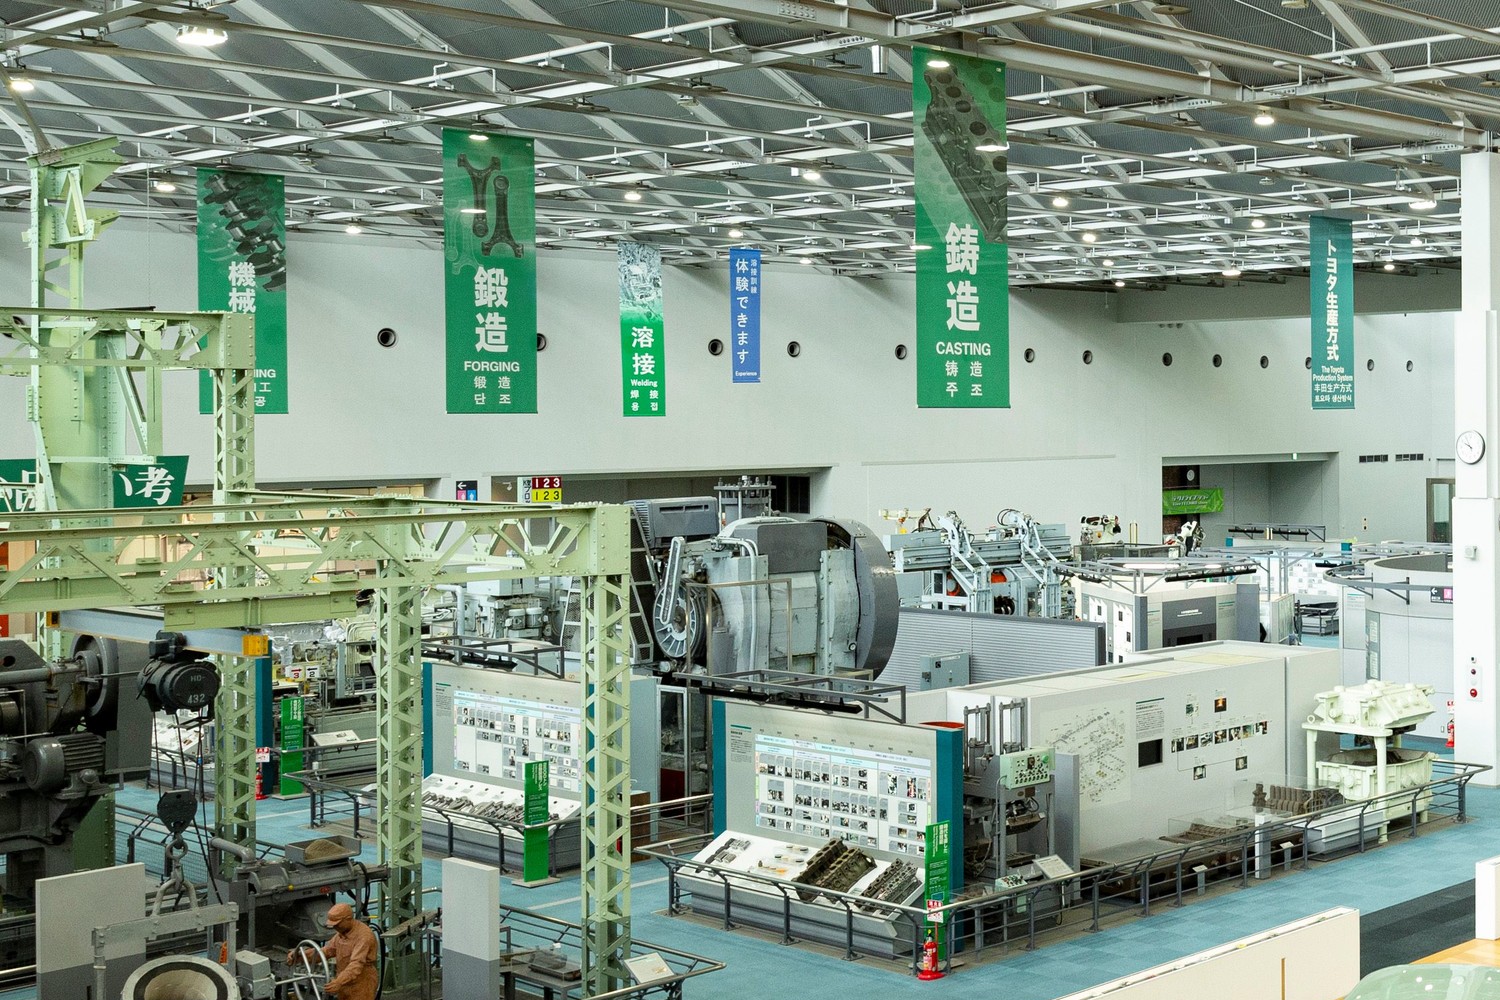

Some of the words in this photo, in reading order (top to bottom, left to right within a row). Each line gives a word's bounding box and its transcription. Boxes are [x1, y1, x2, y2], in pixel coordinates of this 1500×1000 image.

[1326, 239, 1339, 361] トヨタ生産方式
[474, 266, 509, 353] 鍛造
[735, 258, 749, 364] 体験できます
[631, 326, 656, 375] 溶接
[936, 341, 991, 356] CASTING
[464, 361, 520, 372] FORGING
[1321, 365, 1330, 373] The
[1330, 365, 1344, 375] Toyota
[630, 379, 658, 388] Welding
[1337, 374, 1353, 383] System
[946, 382, 983, 397] 주조
[1314, 383, 1352, 393] 丰田生产方式
[474, 392, 511, 405] 단조
[187, 693, 205, 704] 432
